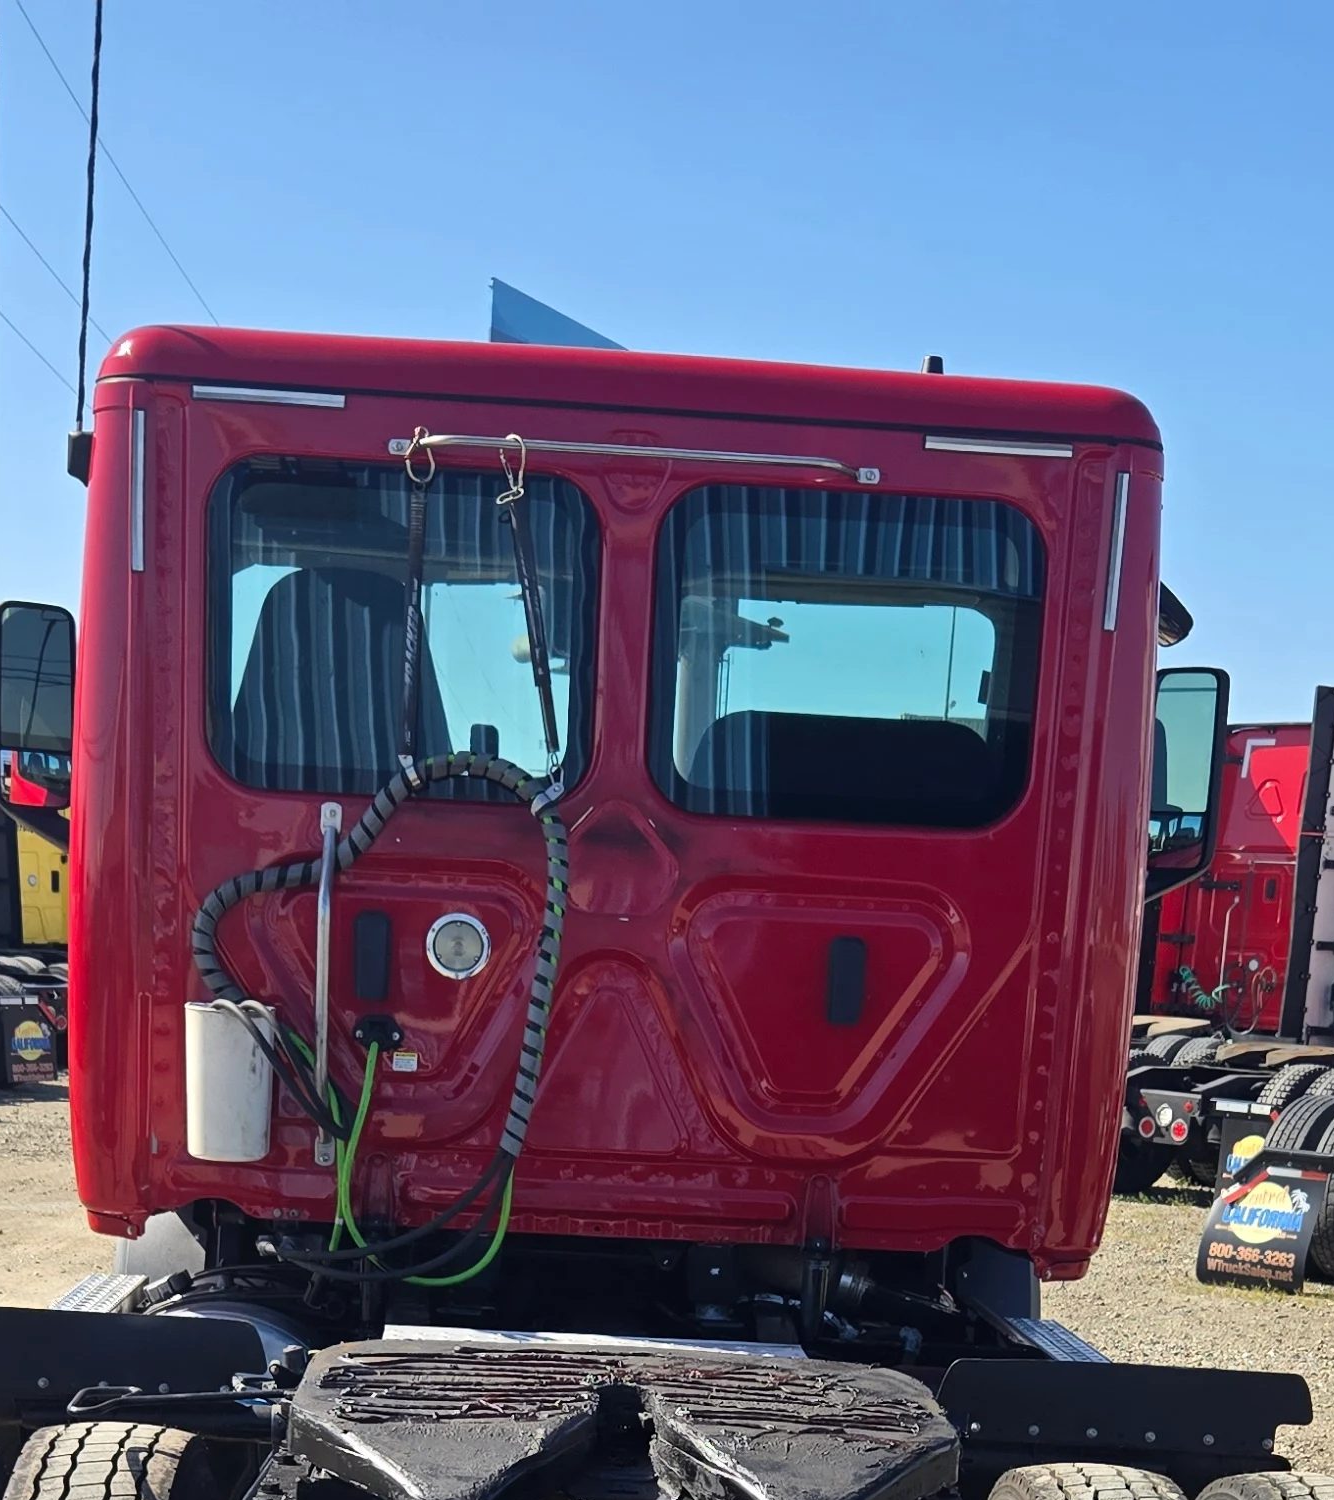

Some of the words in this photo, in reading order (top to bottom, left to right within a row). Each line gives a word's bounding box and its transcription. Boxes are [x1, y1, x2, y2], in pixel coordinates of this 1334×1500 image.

[1221, 1203, 1304, 1233] CALIFORNIA
[1208, 1242, 1296, 1269] 800-366-3263
[1206, 1257, 1294, 1283] WTruckSales.net
